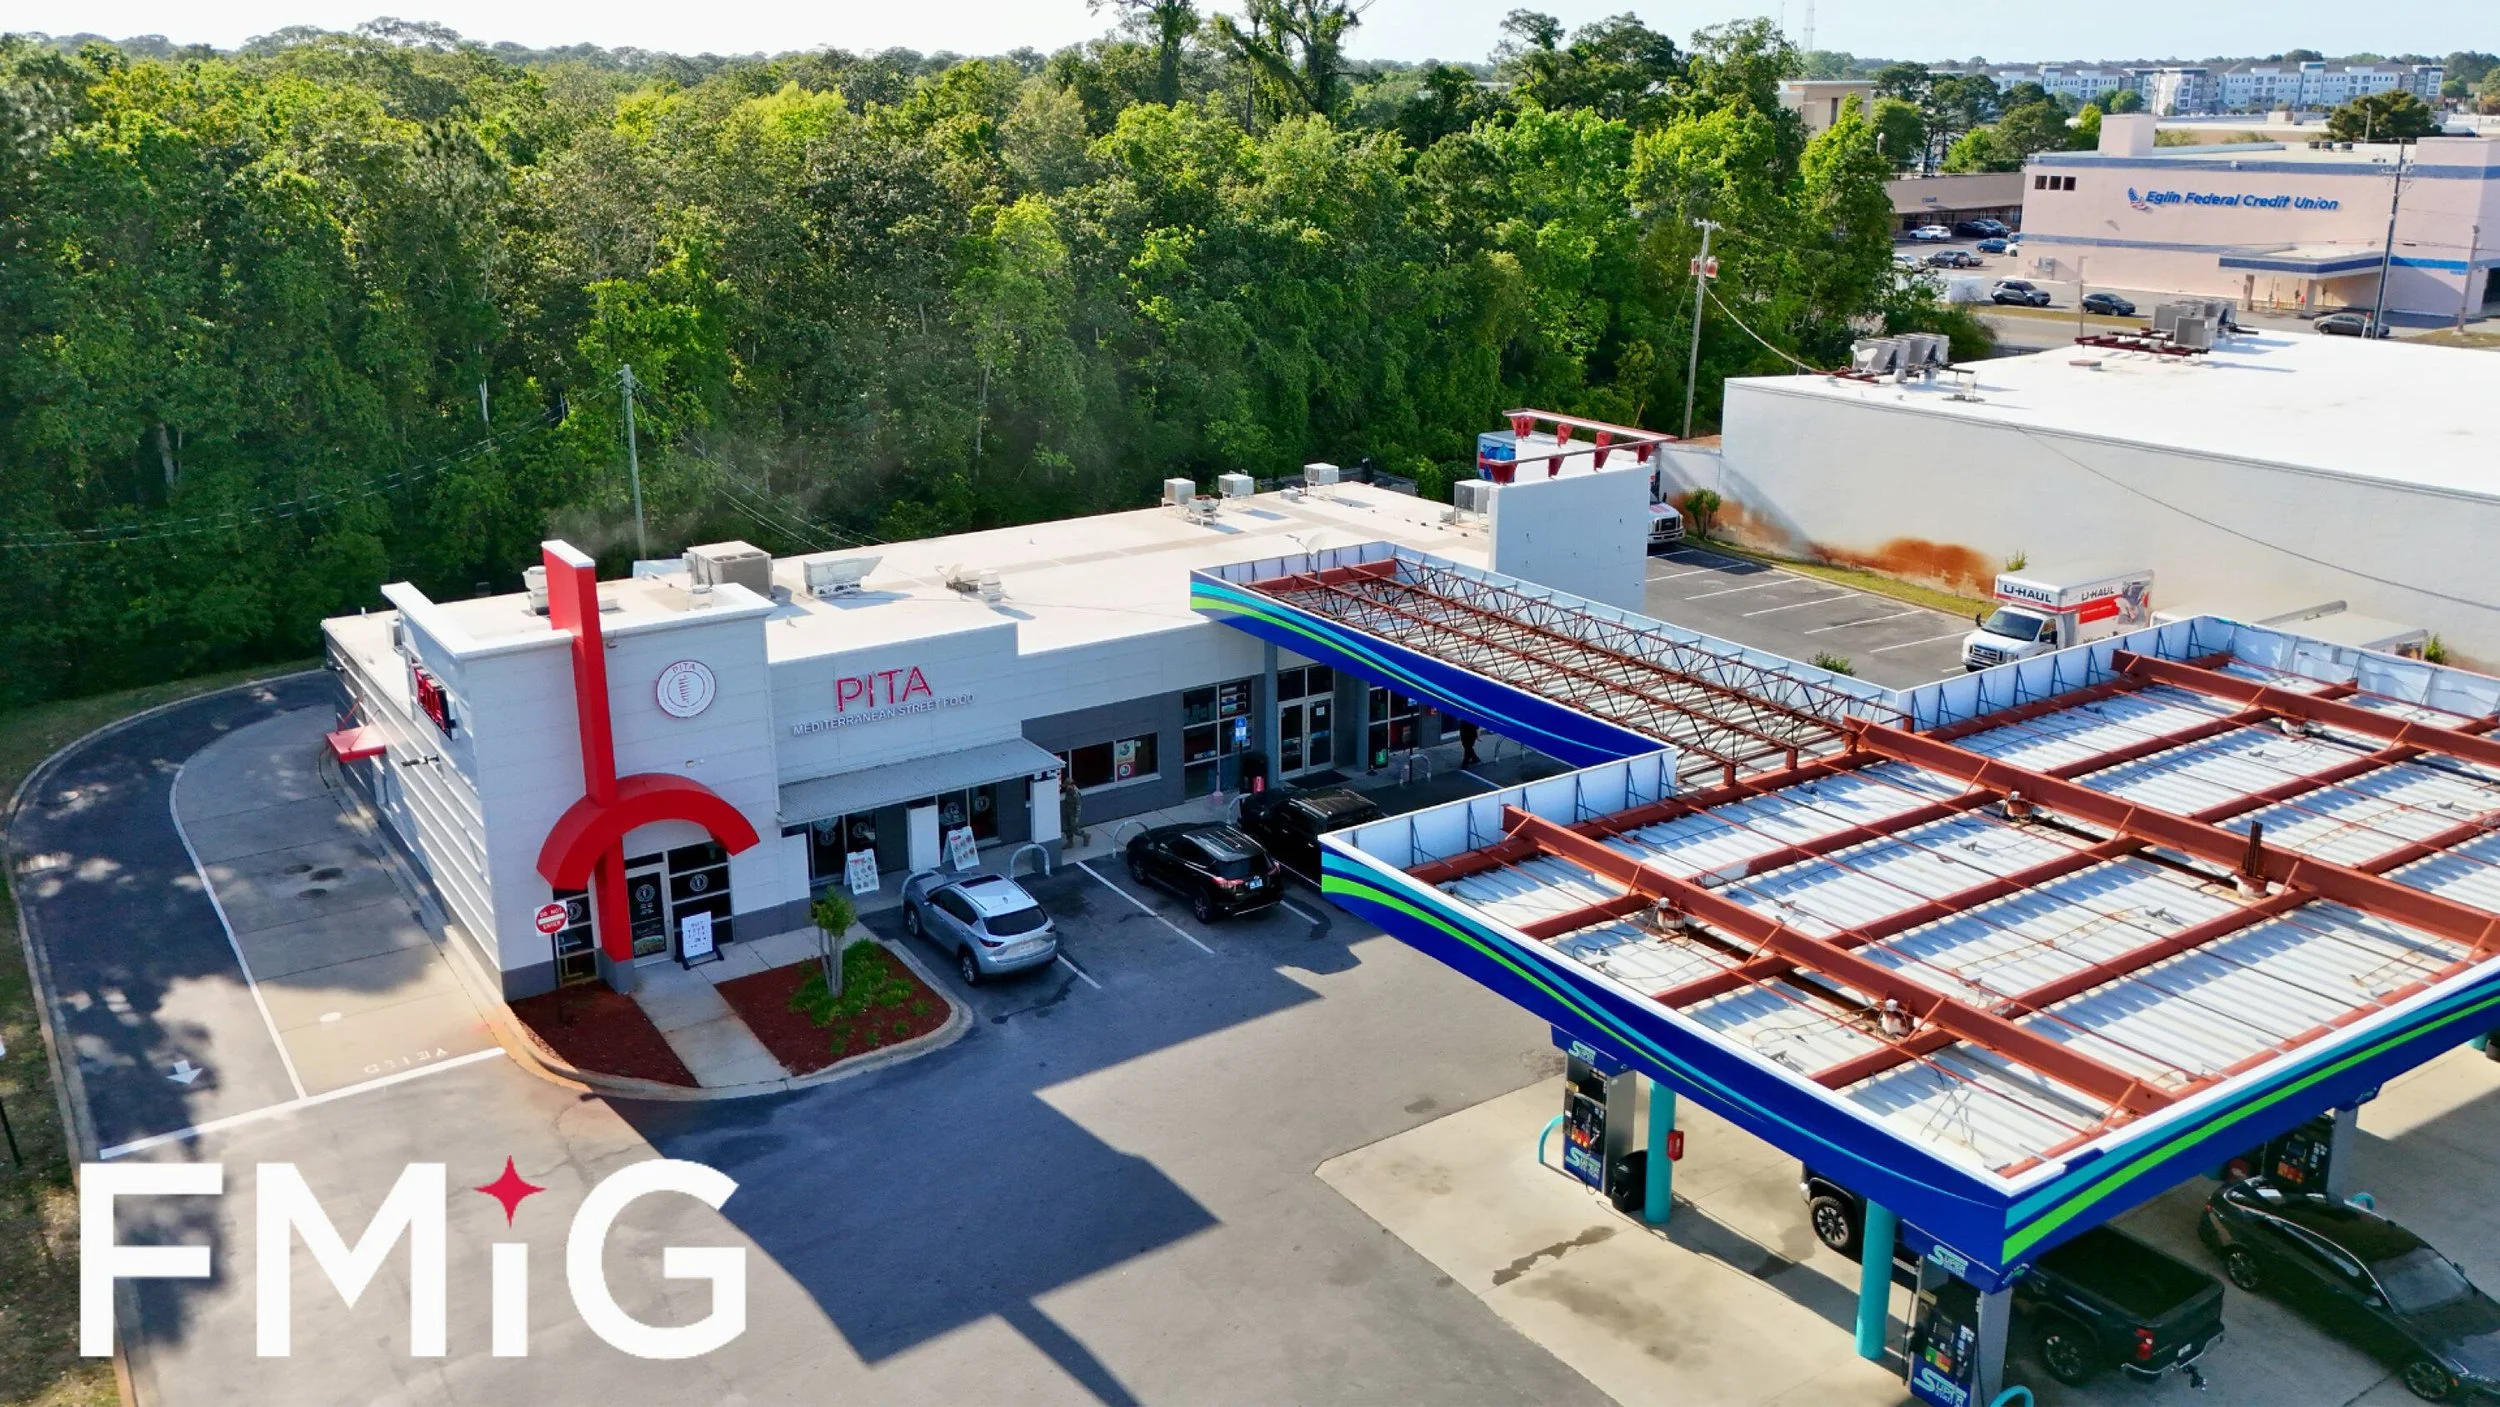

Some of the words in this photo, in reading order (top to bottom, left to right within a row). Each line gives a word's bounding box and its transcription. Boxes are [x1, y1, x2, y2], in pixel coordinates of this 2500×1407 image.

[2146, 191, 2181, 205] Eglin
[2185, 192, 2240, 206] Federal
[2243, 195, 2290, 208] Credit
[2294, 197, 2339, 210] Union
[2003, 584, 2052, 603] U-HAUL
[2081, 586, 2115, 601] U-HAUL
[672, 663, 697, 674] PITA
[836, 666, 932, 713] PITA
[793, 709, 896, 737] MEDITERRANEAN
[899, 700, 940, 717] STREET
[943, 694, 975, 708] FOOD
[551, 907, 562, 915] NOT
[543, 920, 561, 930] ENTER
